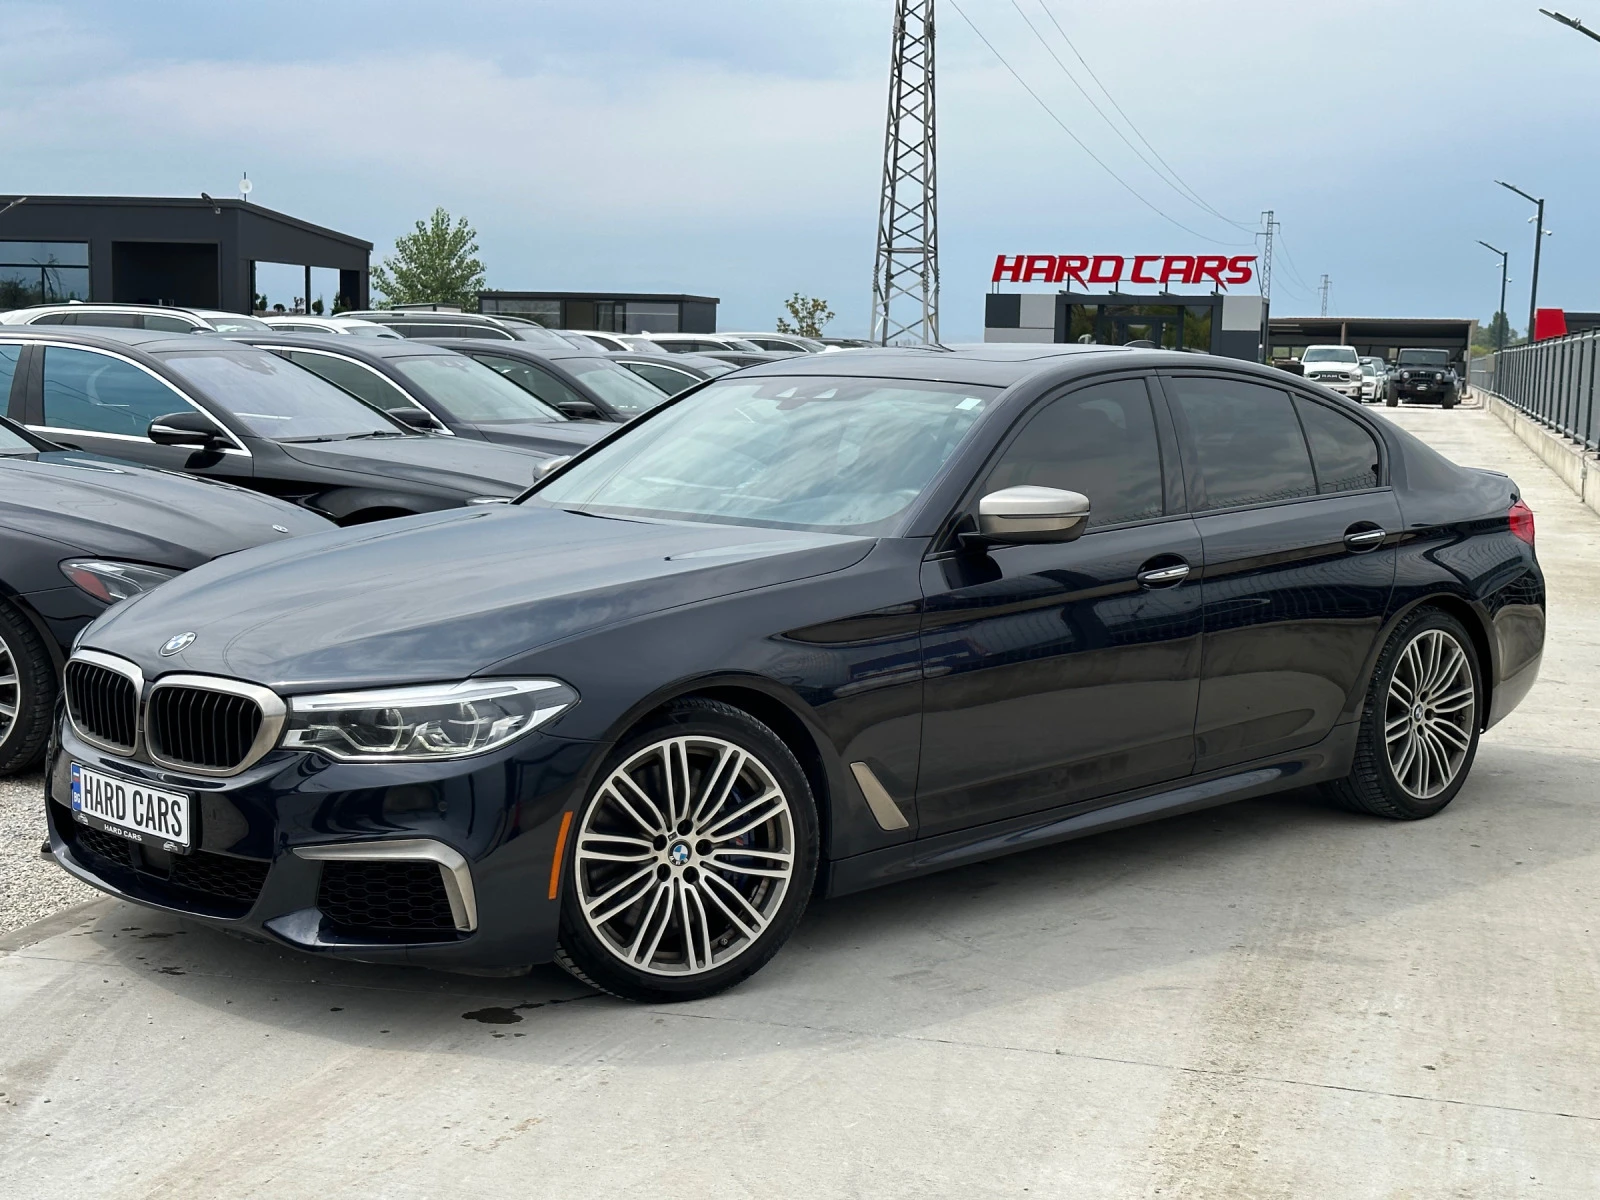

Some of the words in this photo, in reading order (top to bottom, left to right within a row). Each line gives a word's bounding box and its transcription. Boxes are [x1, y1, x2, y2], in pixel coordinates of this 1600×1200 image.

[992, 255, 1124, 292] HARD
[1131, 255, 1258, 292] CARS
[73, 791, 81, 803] BG
[84, 773, 126, 821] HARD
[133, 789, 182, 837] CARS
[104, 823, 122, 836] HARD
[123, 830, 142, 841] CARS
